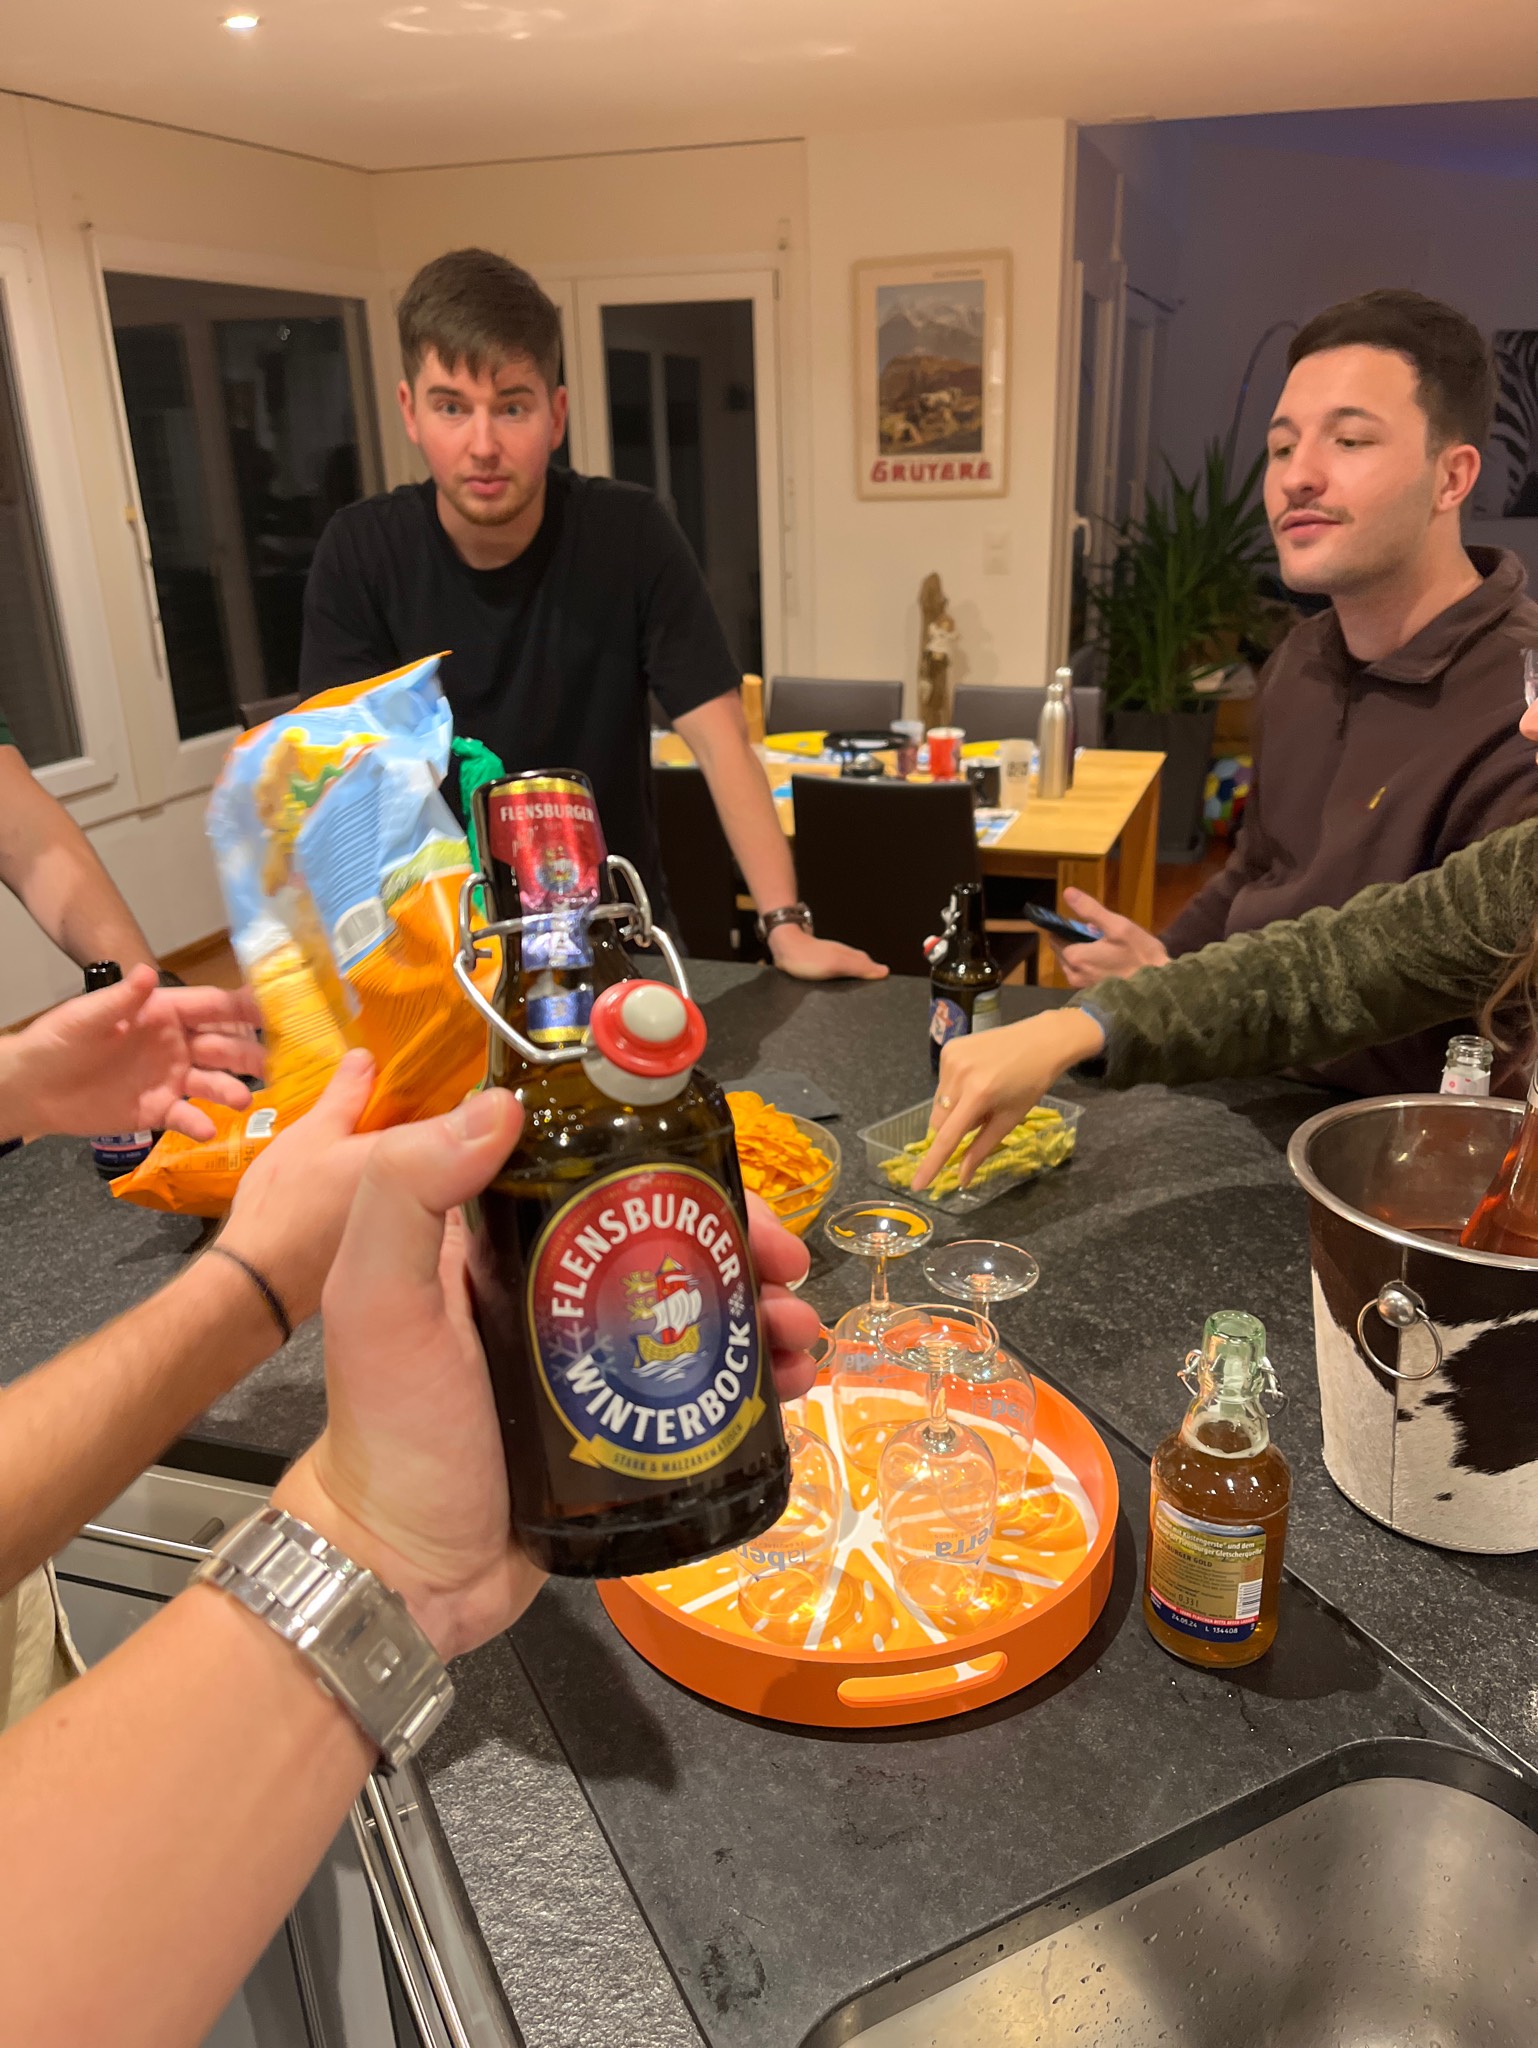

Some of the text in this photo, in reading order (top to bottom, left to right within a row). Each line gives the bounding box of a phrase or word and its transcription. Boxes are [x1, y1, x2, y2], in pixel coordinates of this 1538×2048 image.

[500, 803, 595, 822] FLENSBURGER
[551, 1193, 741, 1318] FLENSBURGER
[566, 1321, 750, 1445] WINTERBOCK
[613, 1452, 646, 1471] STARK
[1227, 1541, 1241, 1550] und
[1241, 1541, 1255, 1549] dem
[1193, 1556, 1213, 1568] GOLD
